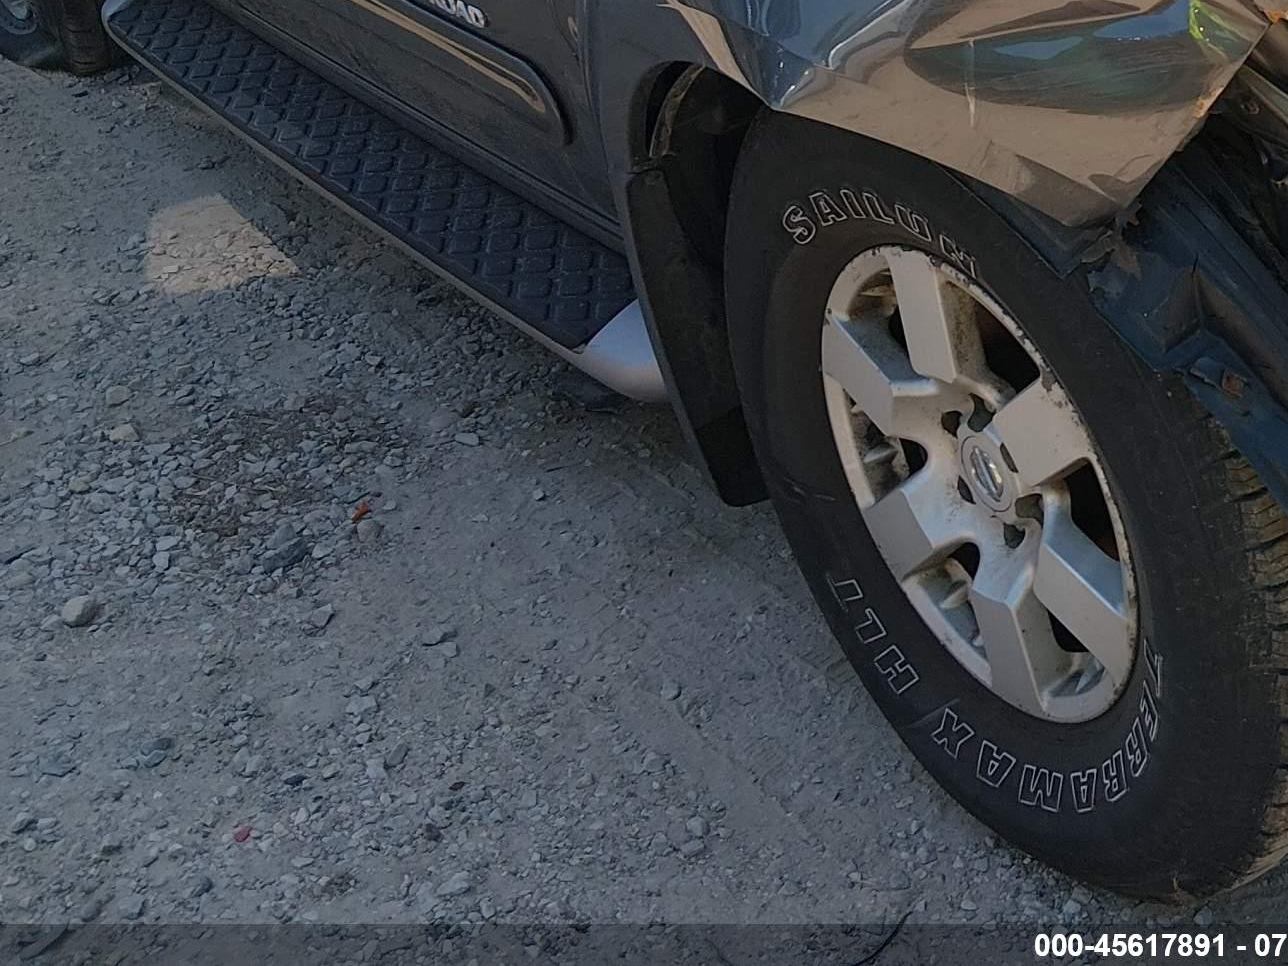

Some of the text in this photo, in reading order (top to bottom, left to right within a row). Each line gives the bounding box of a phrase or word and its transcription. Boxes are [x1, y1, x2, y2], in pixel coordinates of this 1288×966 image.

[782, 188, 977, 280] SAILUN
[825, 571, 1164, 813] TERRAMAX HLT
